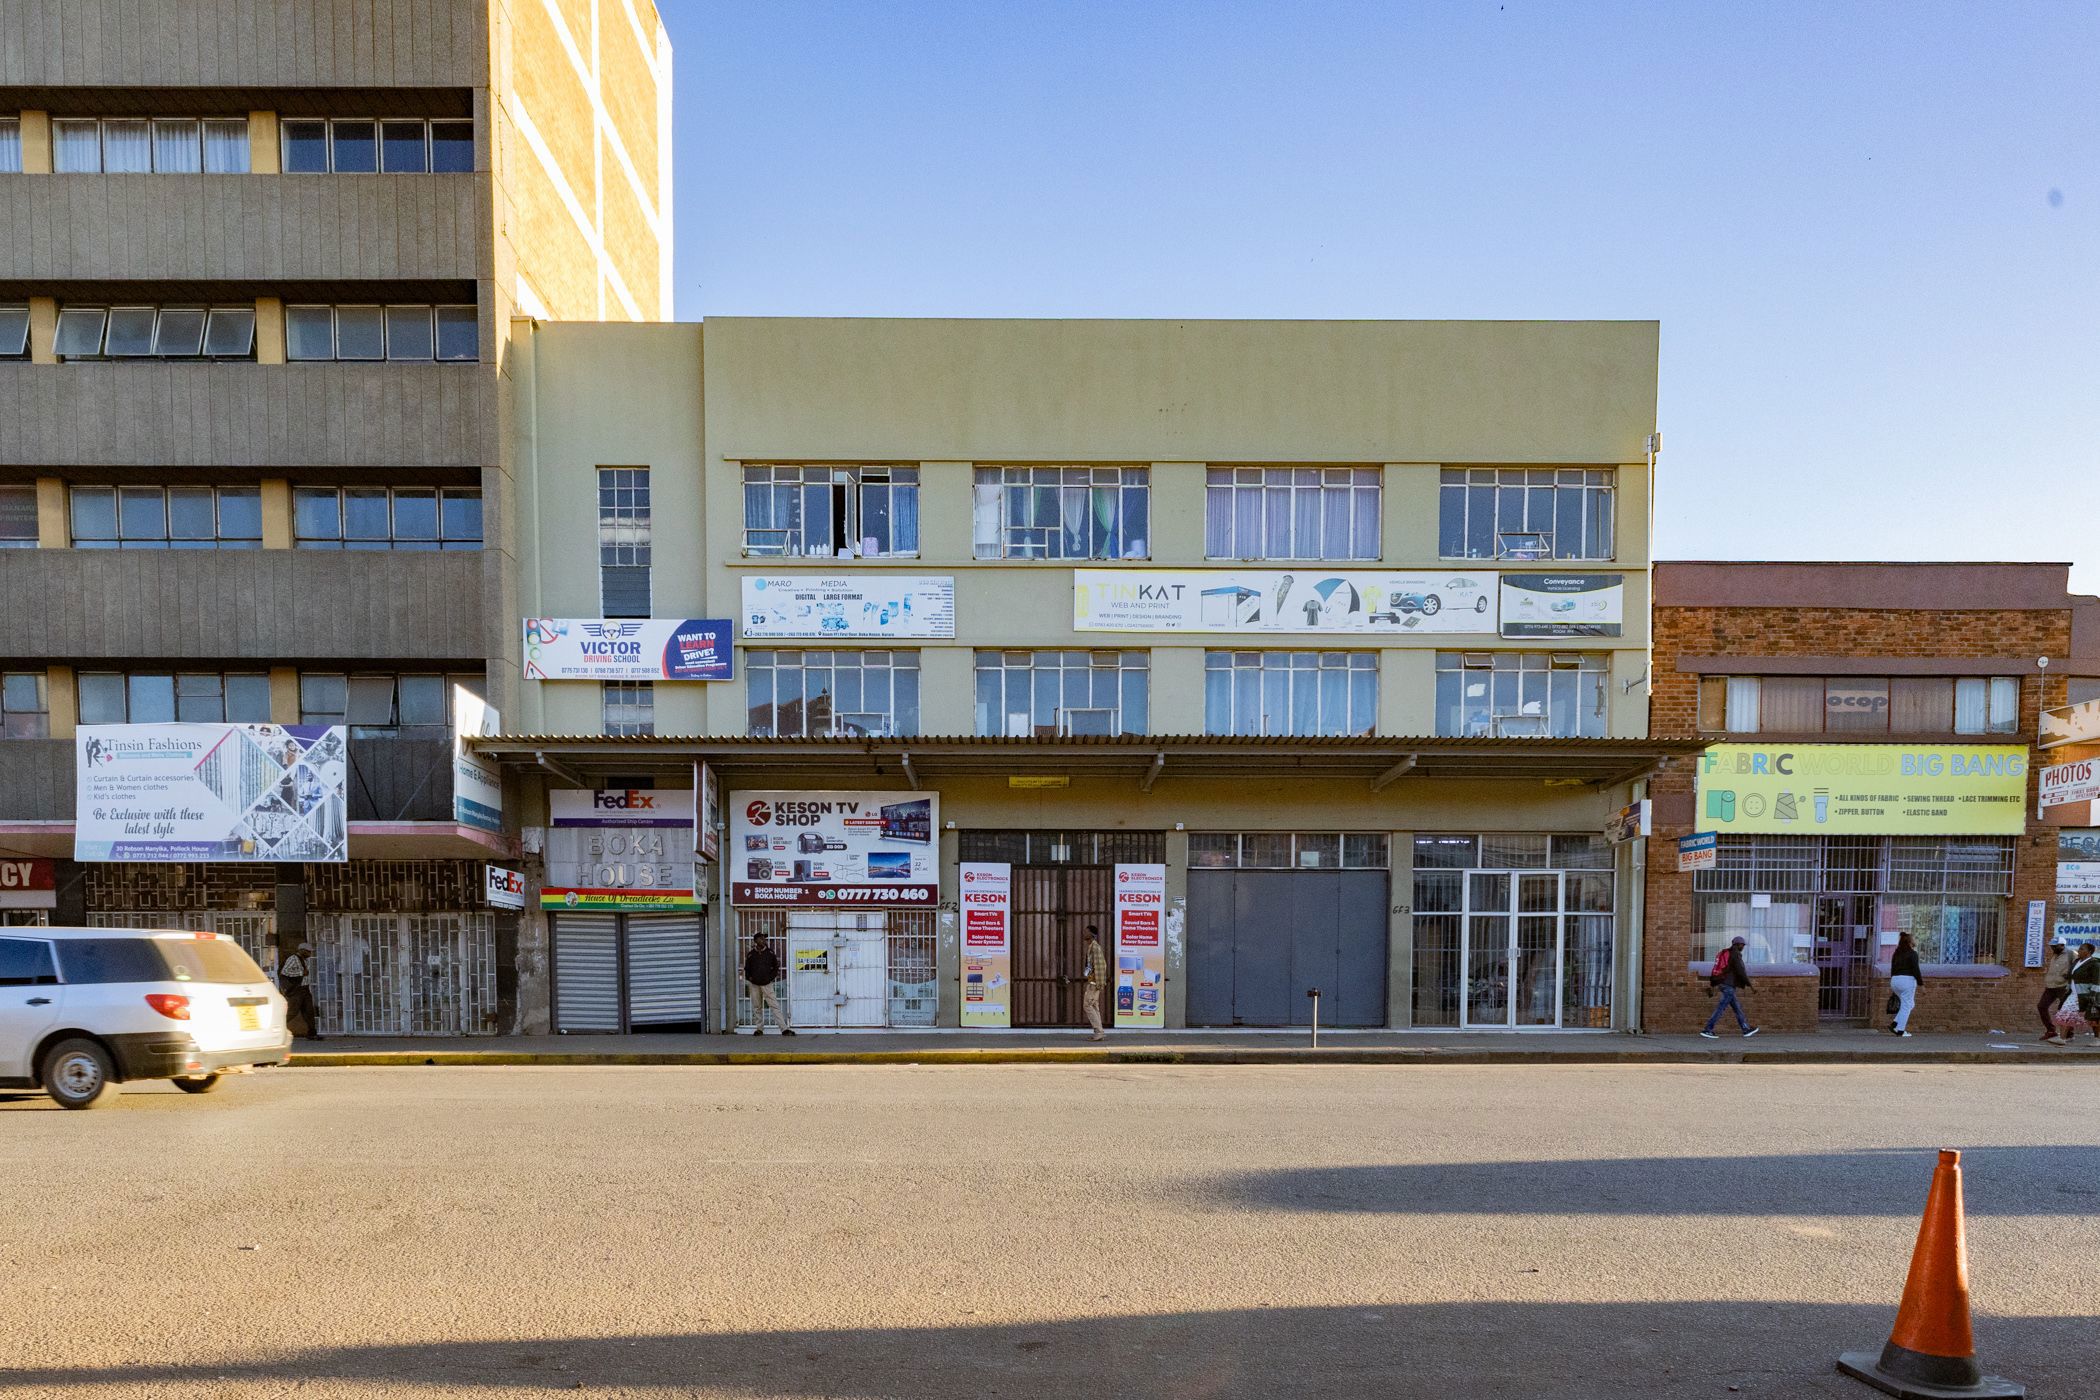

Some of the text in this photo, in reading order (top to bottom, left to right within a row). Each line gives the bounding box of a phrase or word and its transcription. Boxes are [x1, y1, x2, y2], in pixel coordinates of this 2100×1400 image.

[1544, 578, 1585, 586] Conveyance
[1096, 583, 1186, 600] TINKAT
[677, 632, 716, 642] WANT TO
[580, 642, 640, 655] VICTOR
[679, 640, 714, 649] LEARN
[584, 655, 640, 663] DRIVING SCHOOL
[684, 648, 714, 661] DRIVE?
[106, 738, 202, 751] Tinsin Fashions
[1704, 752, 2024, 776] FABRIC WORLD BIG BANG
[154, 774, 194, 782] accessories
[2045, 762, 2092, 788] PHOTOS
[594, 789, 654, 809] FedEx
[1839, 794, 1848, 802] ALL
[1850, 794, 1868, 802] KINDS
[1869, 794, 1877, 802] OF
[92, 807, 204, 820] Be Exclusive with these
[775, 802, 860, 814] KESON TV
[1860, 808, 1884, 816] BUTTON
[775, 814, 821, 826] SHOP
[124, 822, 174, 838] latest style
[588, 834, 664, 856] BOKA
[1680, 836, 1714, 849] FABRIC WORLD
[1682, 849, 1712, 862] BIG BANG
[0, 862, 33, 886] CY
[489, 867, 523, 894] FedEx
[577, 862, 672, 886] HOUSE
[585, 894, 660, 904] House Of Dreadlocks
[837, 888, 928, 900] 0777 730 460
[964, 894, 1006, 903] KESON
[1119, 894, 1161, 903] KESON
[1392, 906, 1410, 914] GF3
[2028, 918, 2040, 966] PHOTOCOPYING
